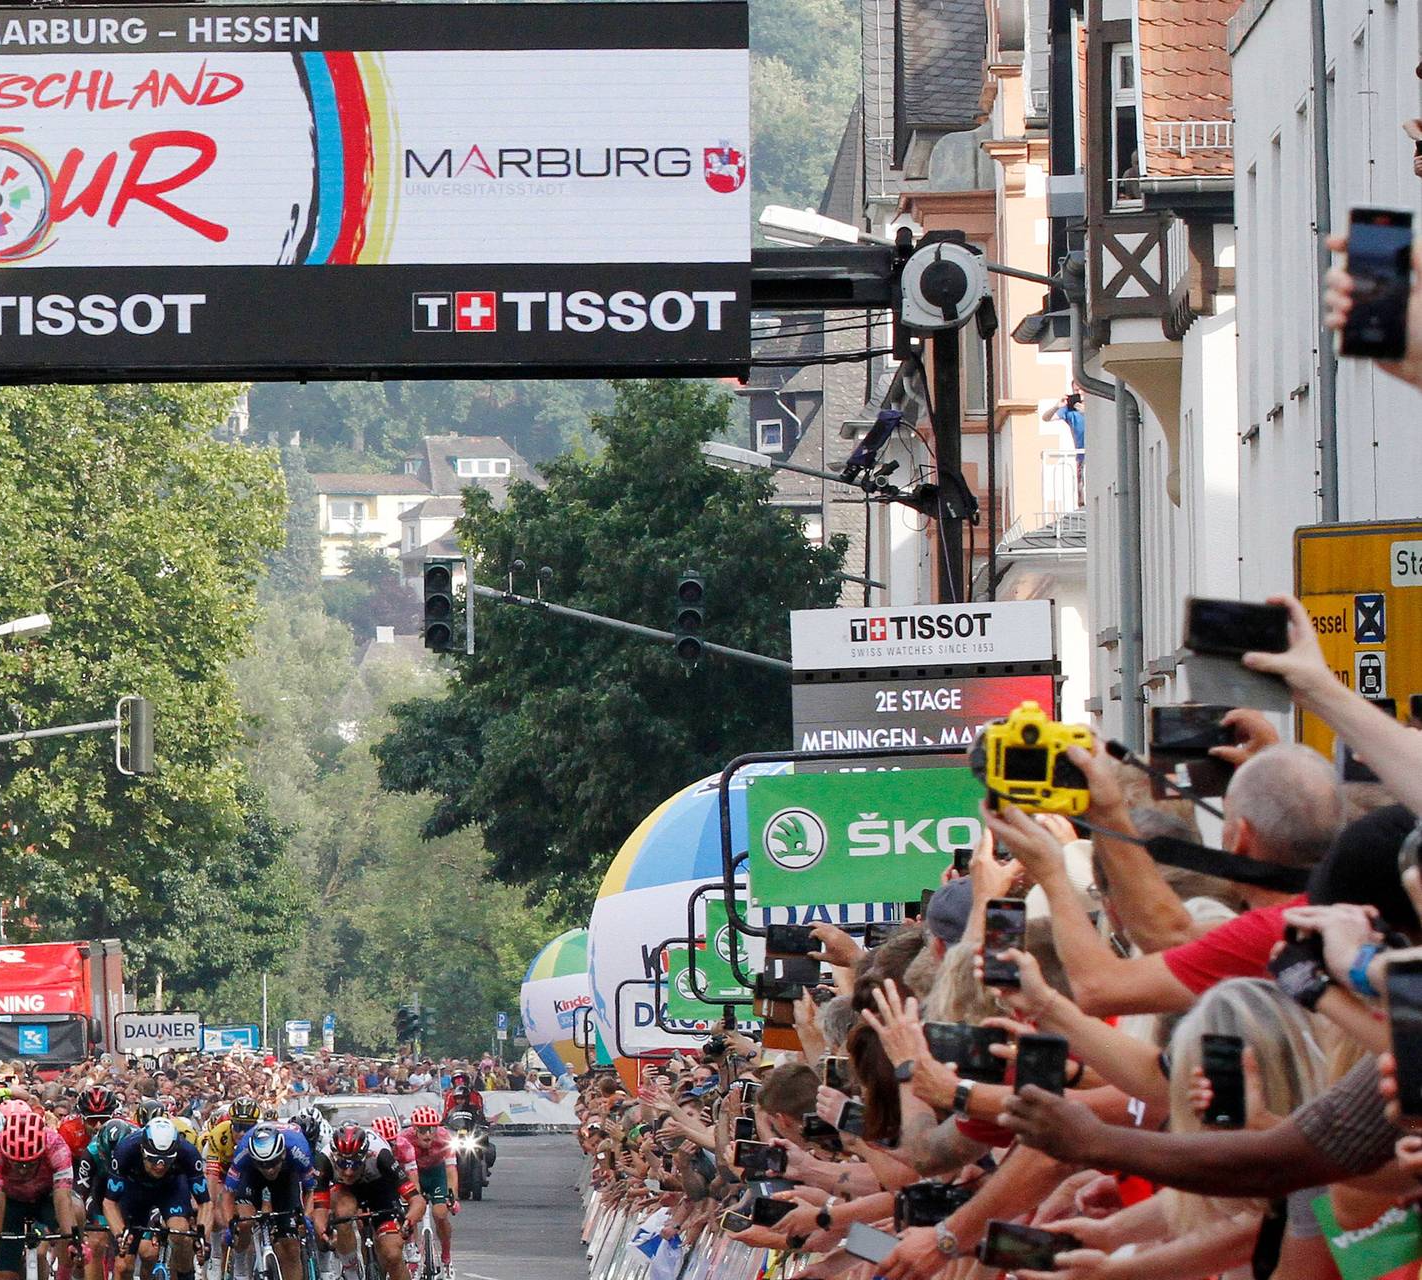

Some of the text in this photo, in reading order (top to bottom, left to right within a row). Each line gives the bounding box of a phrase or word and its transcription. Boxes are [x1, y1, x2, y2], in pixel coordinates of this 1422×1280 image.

[188, 16, 319, 43] HESSEN
[405, 144, 691, 179] MARBURG
[502, 290, 736, 334] TISSOT
[890, 613, 992, 640] TISSOT
[1307, 607, 1348, 634] assel
[851, 643, 995, 658] SWISS WATCHES SINCE 1853
[875, 688, 962, 712] 2E STAGE
[801, 728, 916, 751] MEININGEN
[847, 813, 981, 858] ŠKO
[554, 995, 591, 1014] Kinde
[124, 1023, 196, 1039] DAUNER
